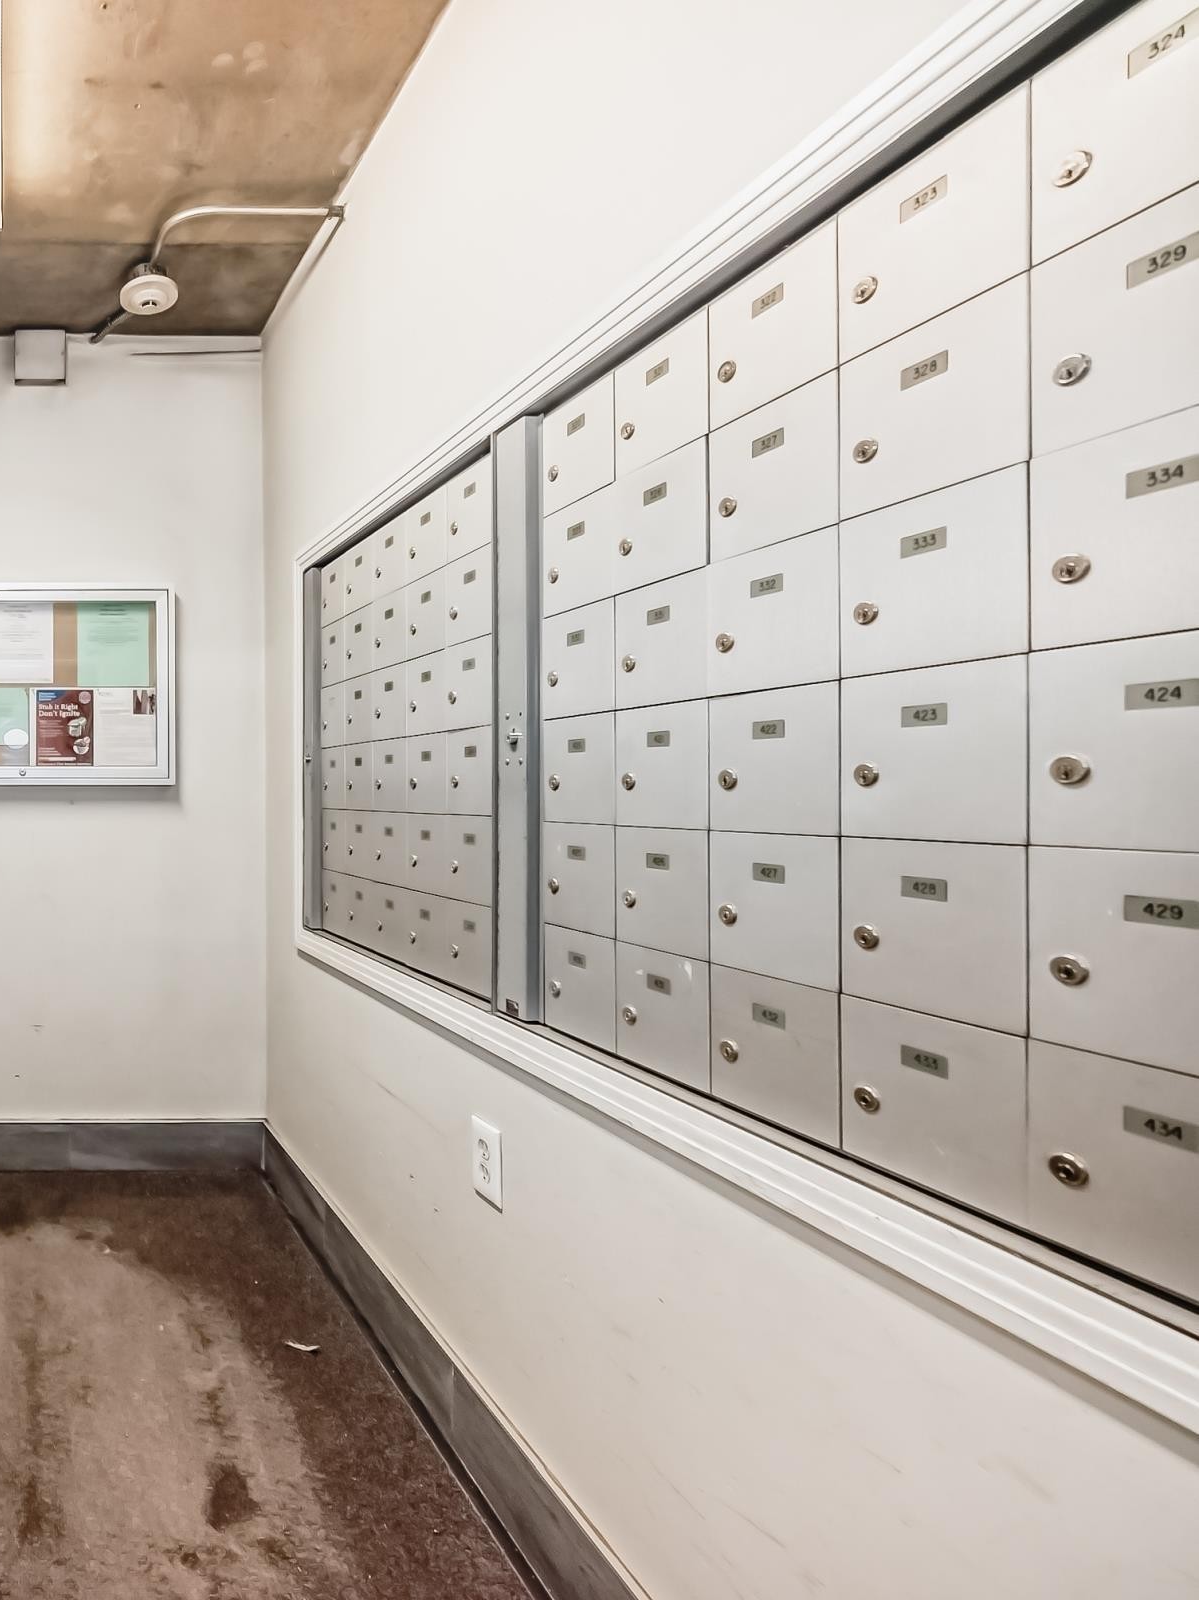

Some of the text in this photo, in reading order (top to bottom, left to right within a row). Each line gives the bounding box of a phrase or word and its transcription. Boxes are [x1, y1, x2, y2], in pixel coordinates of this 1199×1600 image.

[1148, 24, 1185, 59] 324
[914, 186, 938, 211] 323
[1146, 244, 1187, 274] 329
[913, 359, 937, 380] 328
[1146, 464, 1184, 488] 334
[913, 533, 937, 551] 333
[1143, 685, 1182, 702] 424
[59, 710, 80, 718] Ignite
[60, 703, 78, 711] Right
[913, 708, 938, 722] 423
[760, 723, 777, 735] 422
[760, 867, 778, 879] 427
[912, 881, 937, 895] 428
[1142, 902, 1184, 920] 429
[913, 1053, 939, 1070] 433
[1143, 1118, 1183, 1141] 434
